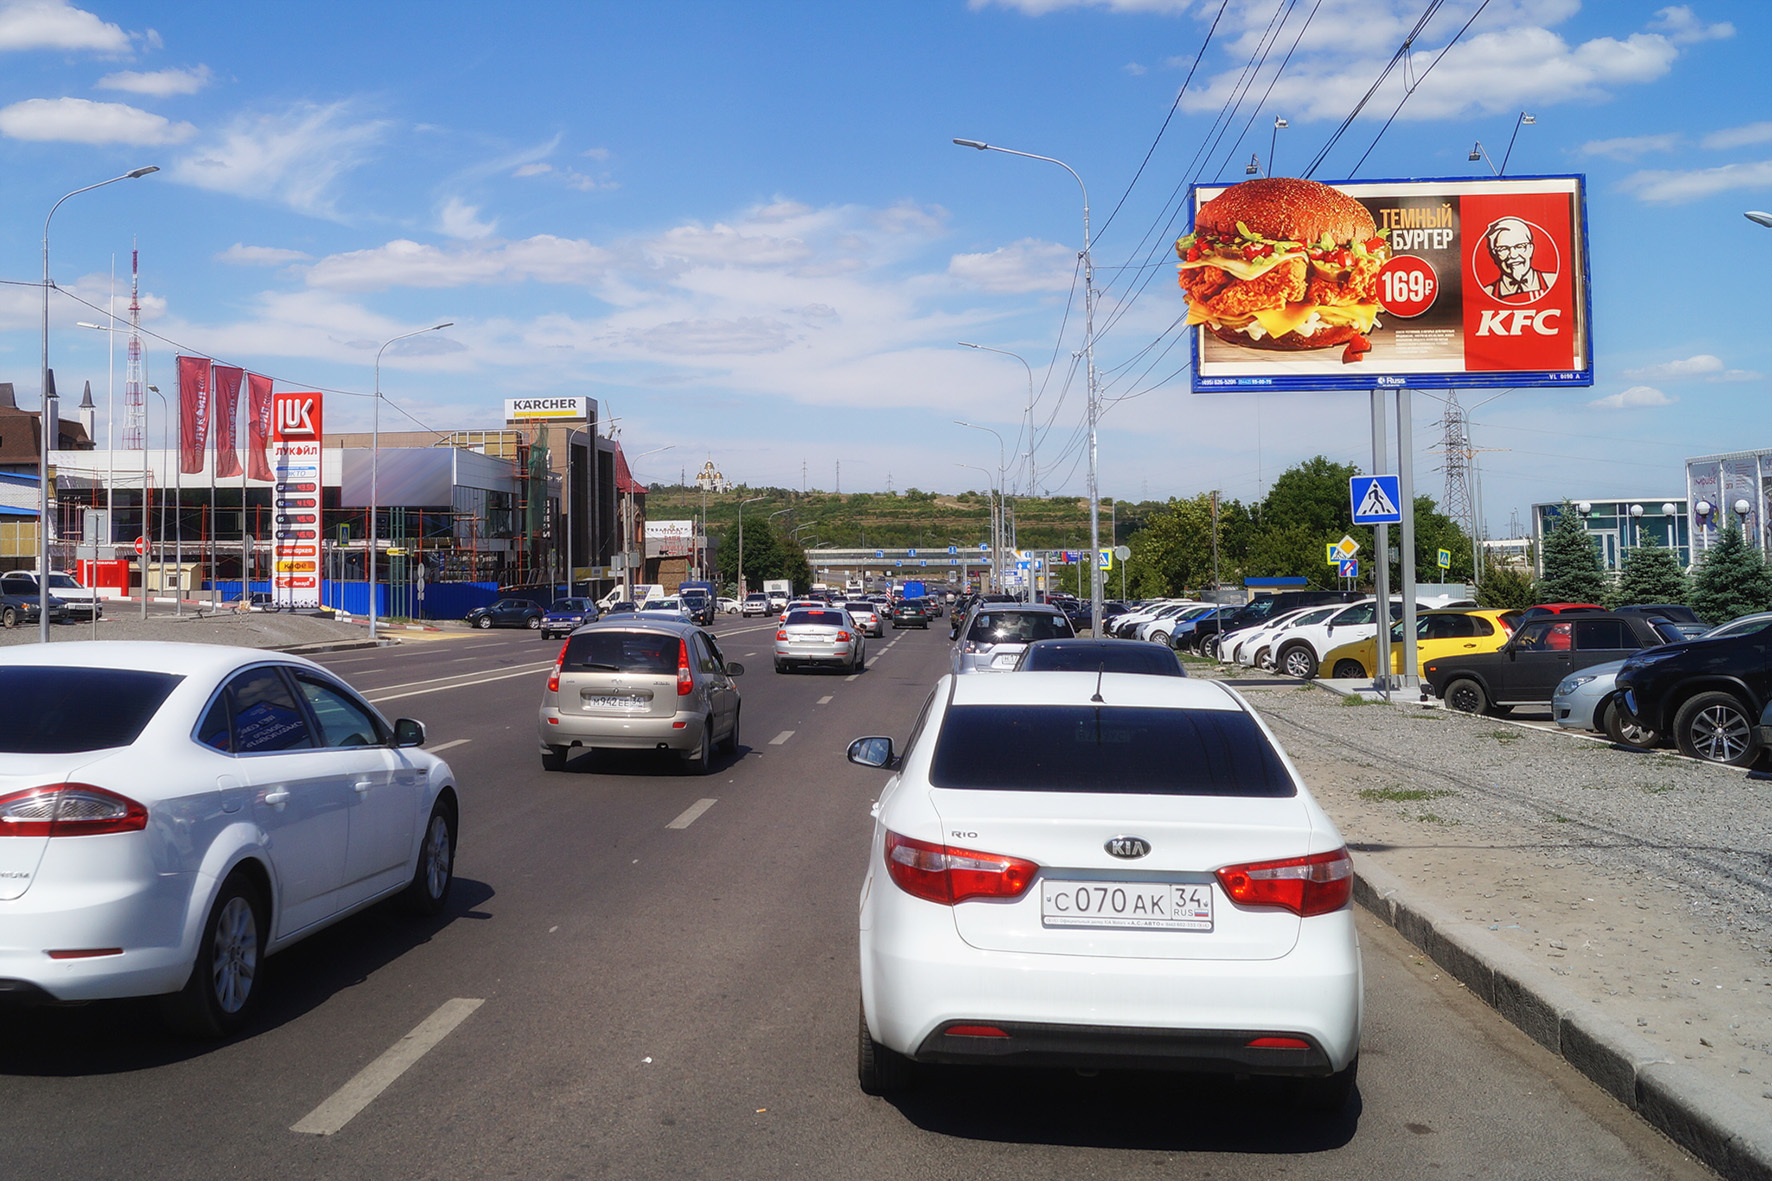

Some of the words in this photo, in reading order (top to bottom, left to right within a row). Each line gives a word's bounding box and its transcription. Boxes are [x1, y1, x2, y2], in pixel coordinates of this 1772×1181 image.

[1380, 203, 1452, 229] ТЕМНЫЙ
[1392, 229, 1453, 250] БУРГЕР
[1475, 308, 1561, 336] KFC
[514, 398, 577, 410] KÄRCHER
[275, 445, 318, 456] ЛУКОЙЛ
[951, 831, 978, 839] RIO
[1111, 840, 1145, 855] KIA
[1055, 886, 1165, 915] С070АК
[1175, 888, 1201, 908] 34
[1174, 908, 1194, 917] RUS
